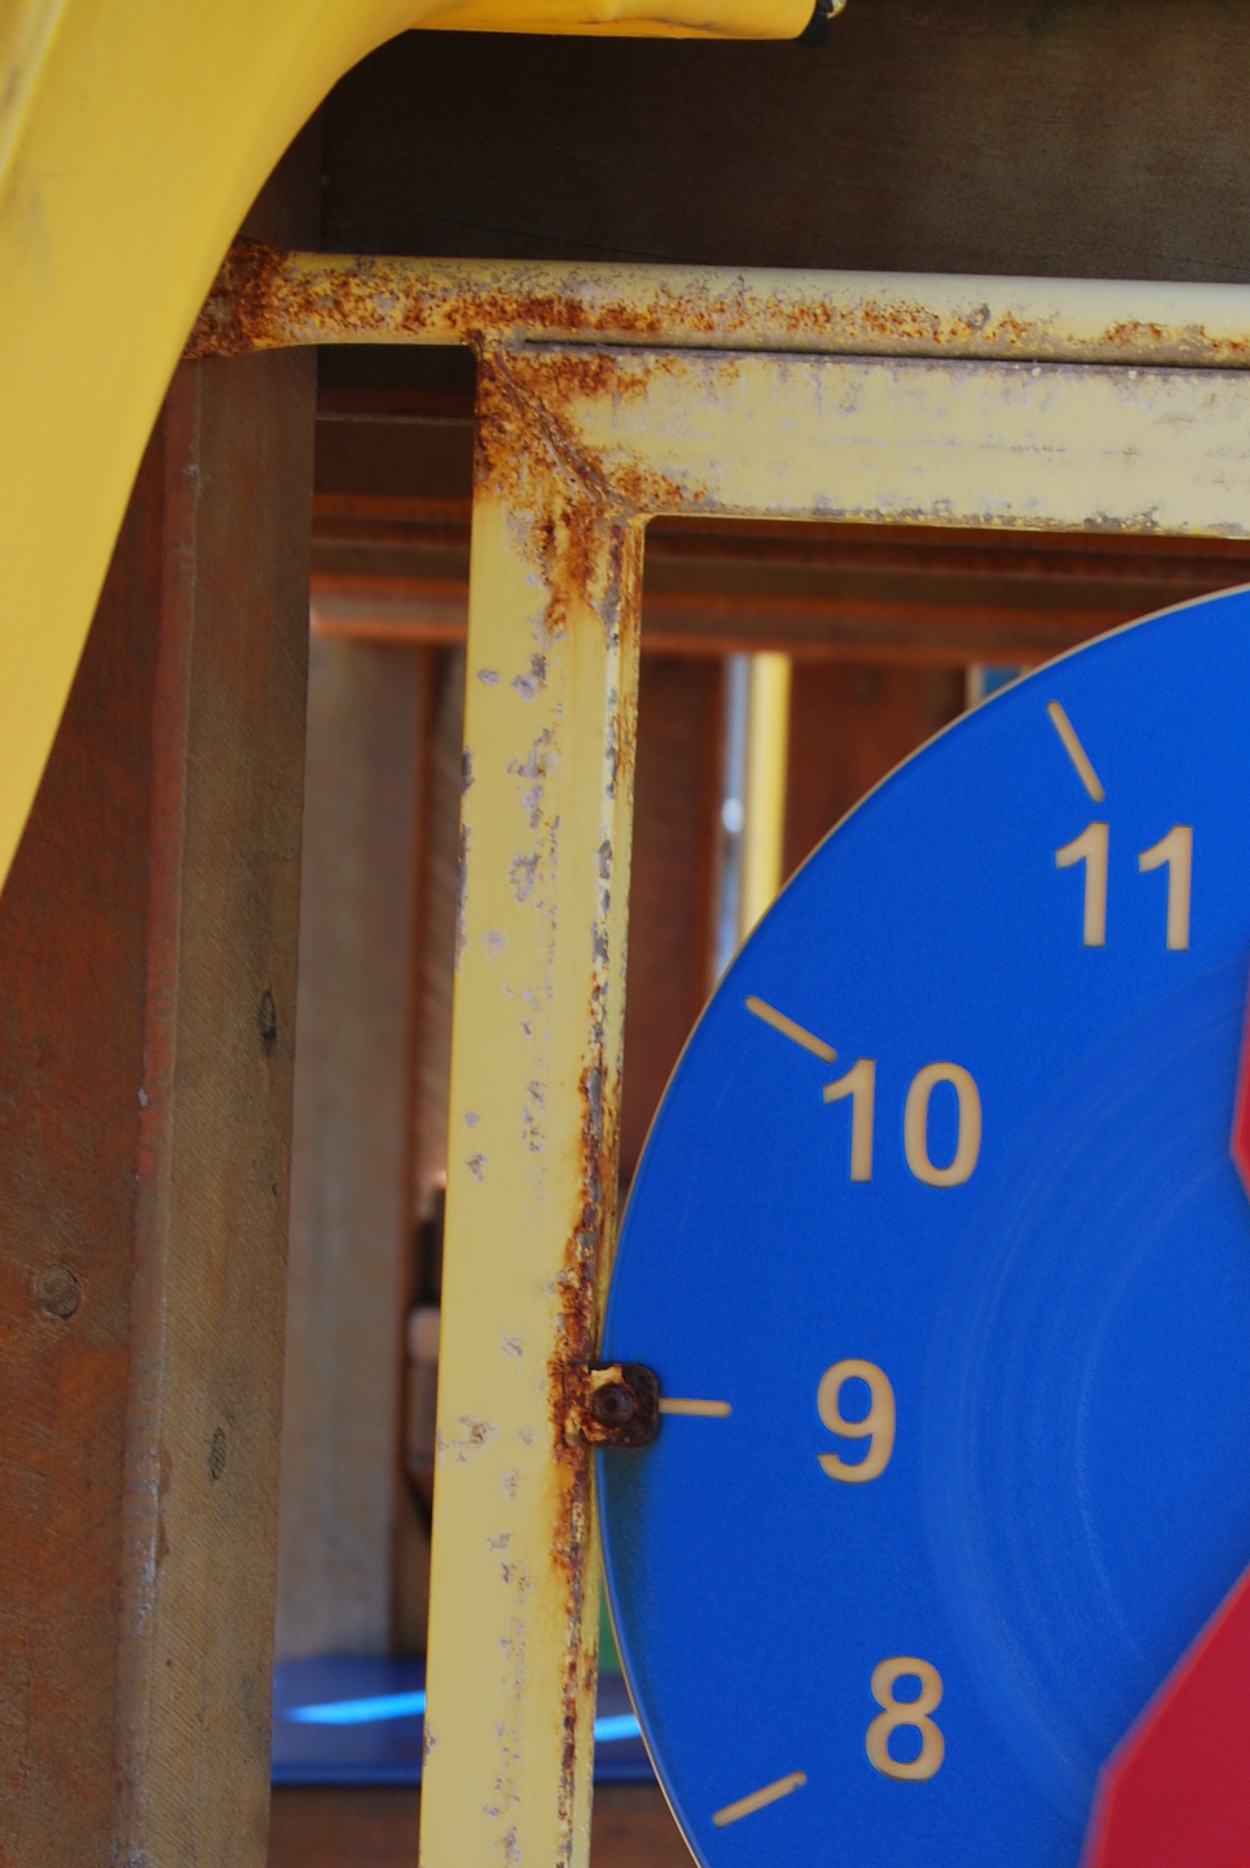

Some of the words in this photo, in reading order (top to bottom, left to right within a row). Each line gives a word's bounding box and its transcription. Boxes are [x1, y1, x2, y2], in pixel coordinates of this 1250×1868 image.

[1054, 822, 1194, 951] 11
[822, 1059, 982, 1188] 10
[815, 1358, 896, 1483] 9
[864, 1656, 945, 1781] 8
